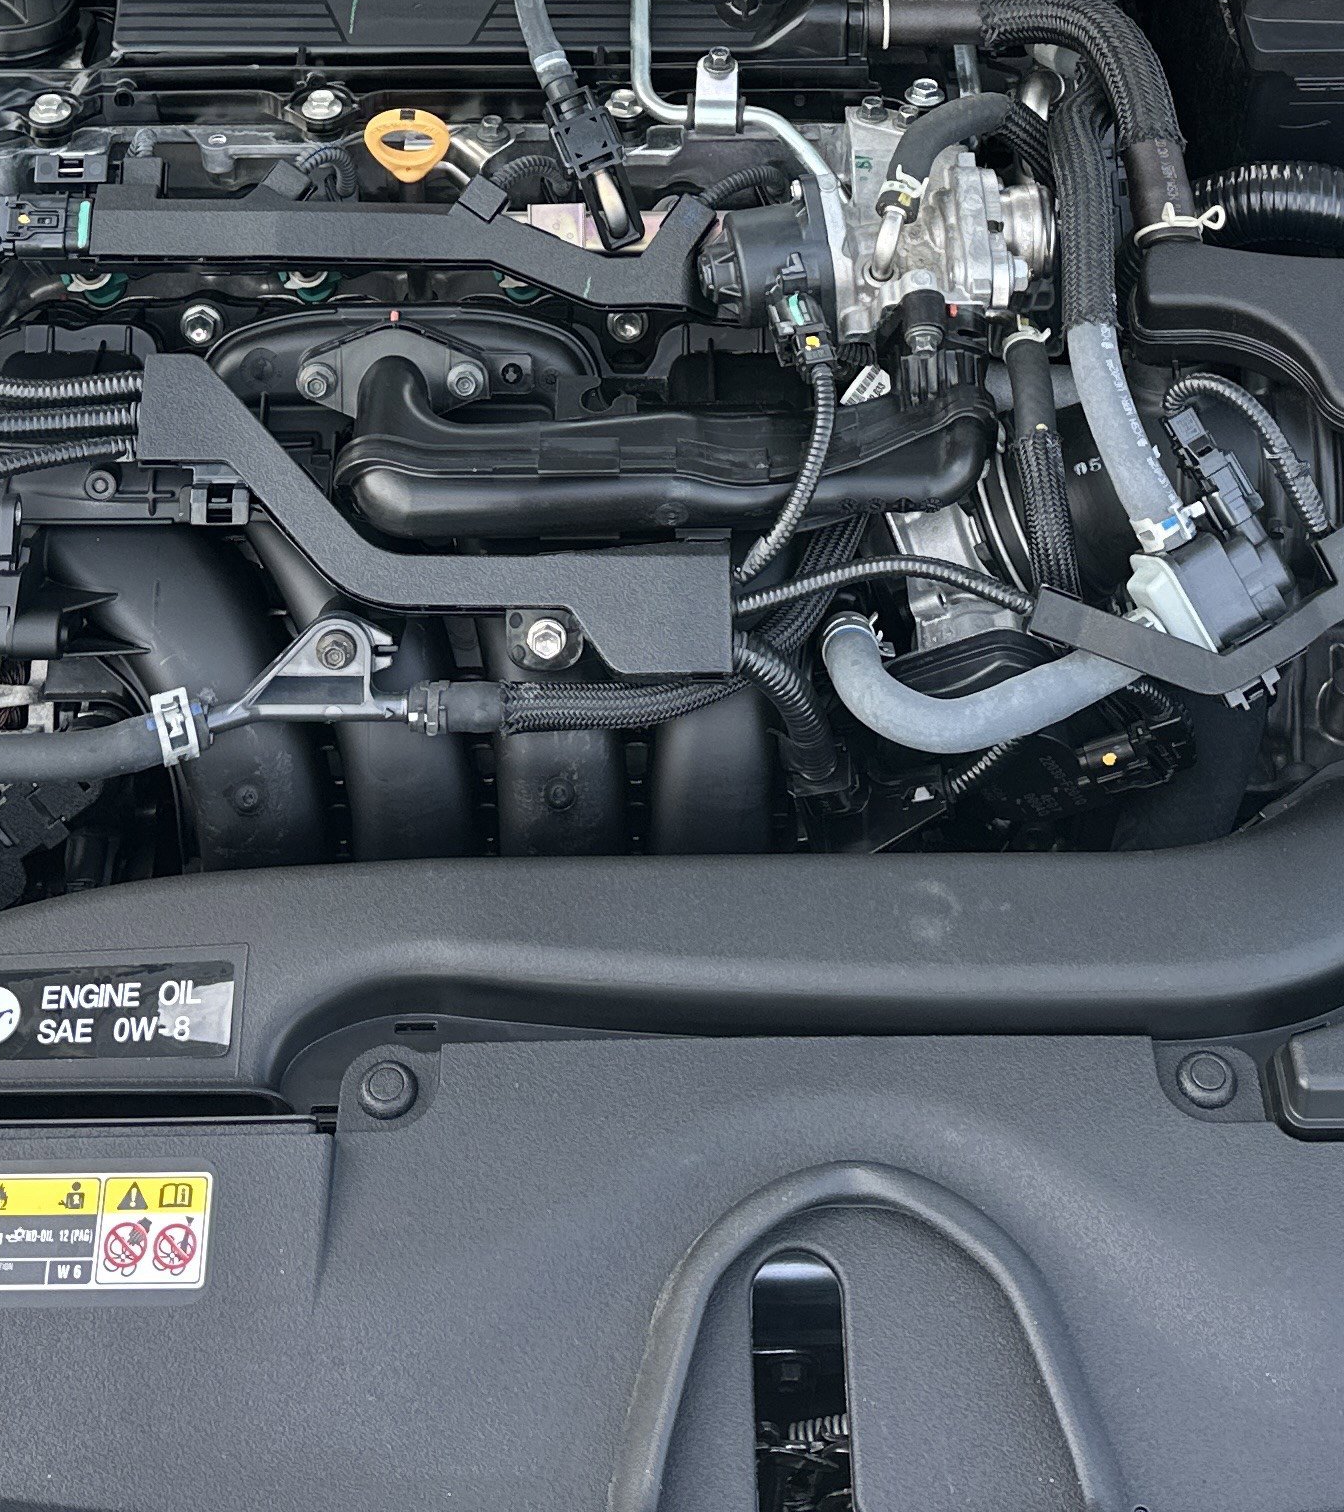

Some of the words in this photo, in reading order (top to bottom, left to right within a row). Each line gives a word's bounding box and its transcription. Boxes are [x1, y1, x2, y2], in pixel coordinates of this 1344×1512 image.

[41, 982, 141, 1009] ENGINE
[158, 980, 201, 1005] OIL
[37, 1018, 93, 1044] SAE
[113, 1016, 190, 1042] 0W-8
[59, 1230, 68, 1241] 12
[70, 1229, 92, 1244] (PAG)
[57, 1264, 69, 1279] W
[73, 1264, 82, 1279] 6
